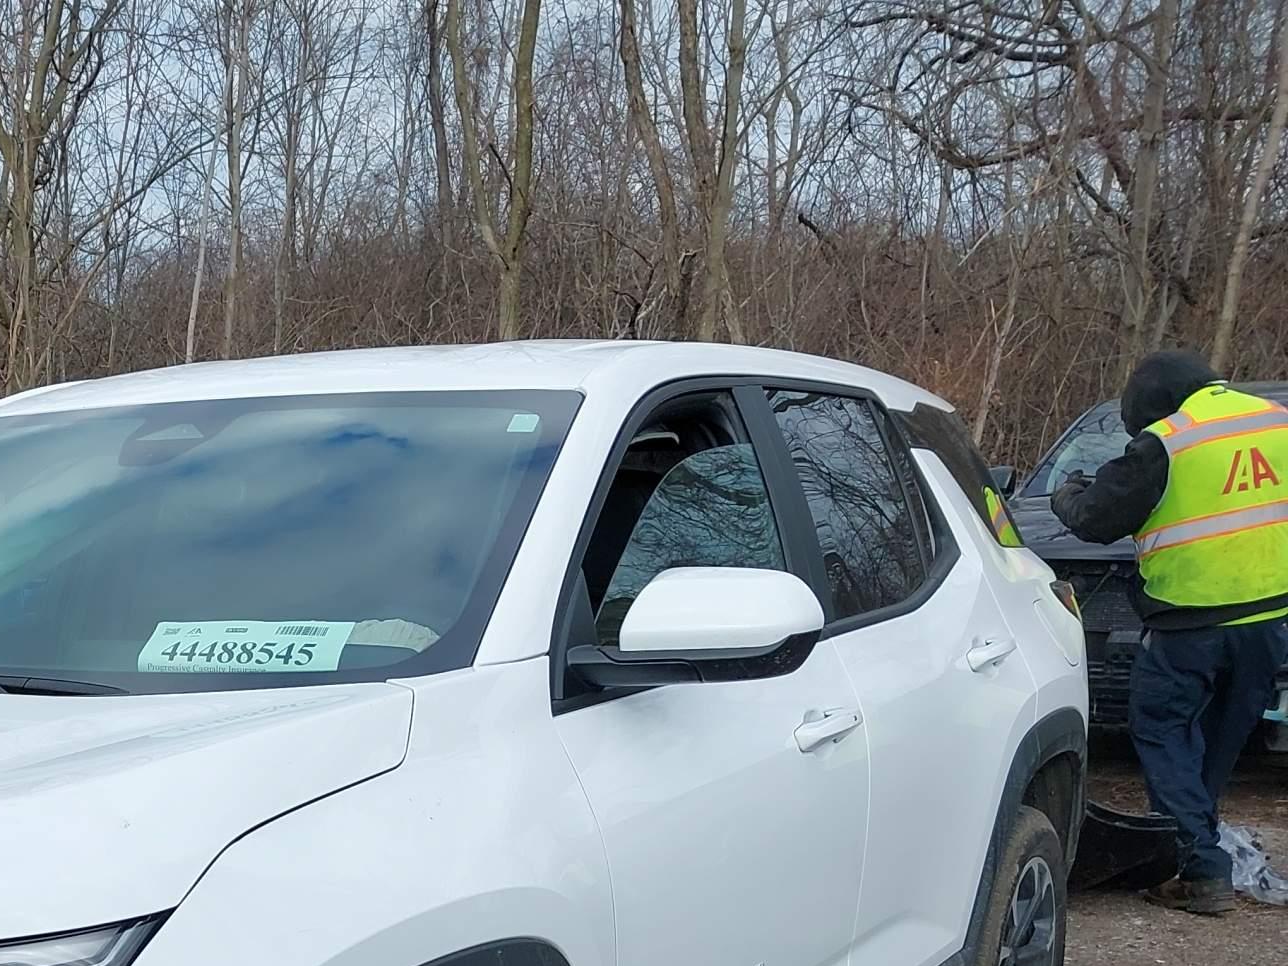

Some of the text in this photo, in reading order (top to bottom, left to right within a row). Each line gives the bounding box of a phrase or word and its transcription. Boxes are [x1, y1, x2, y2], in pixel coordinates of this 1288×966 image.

[161, 641, 317, 665] 44488545
[147, 663, 191, 673] Progressive
[192, 664, 226, 673] Casualty
